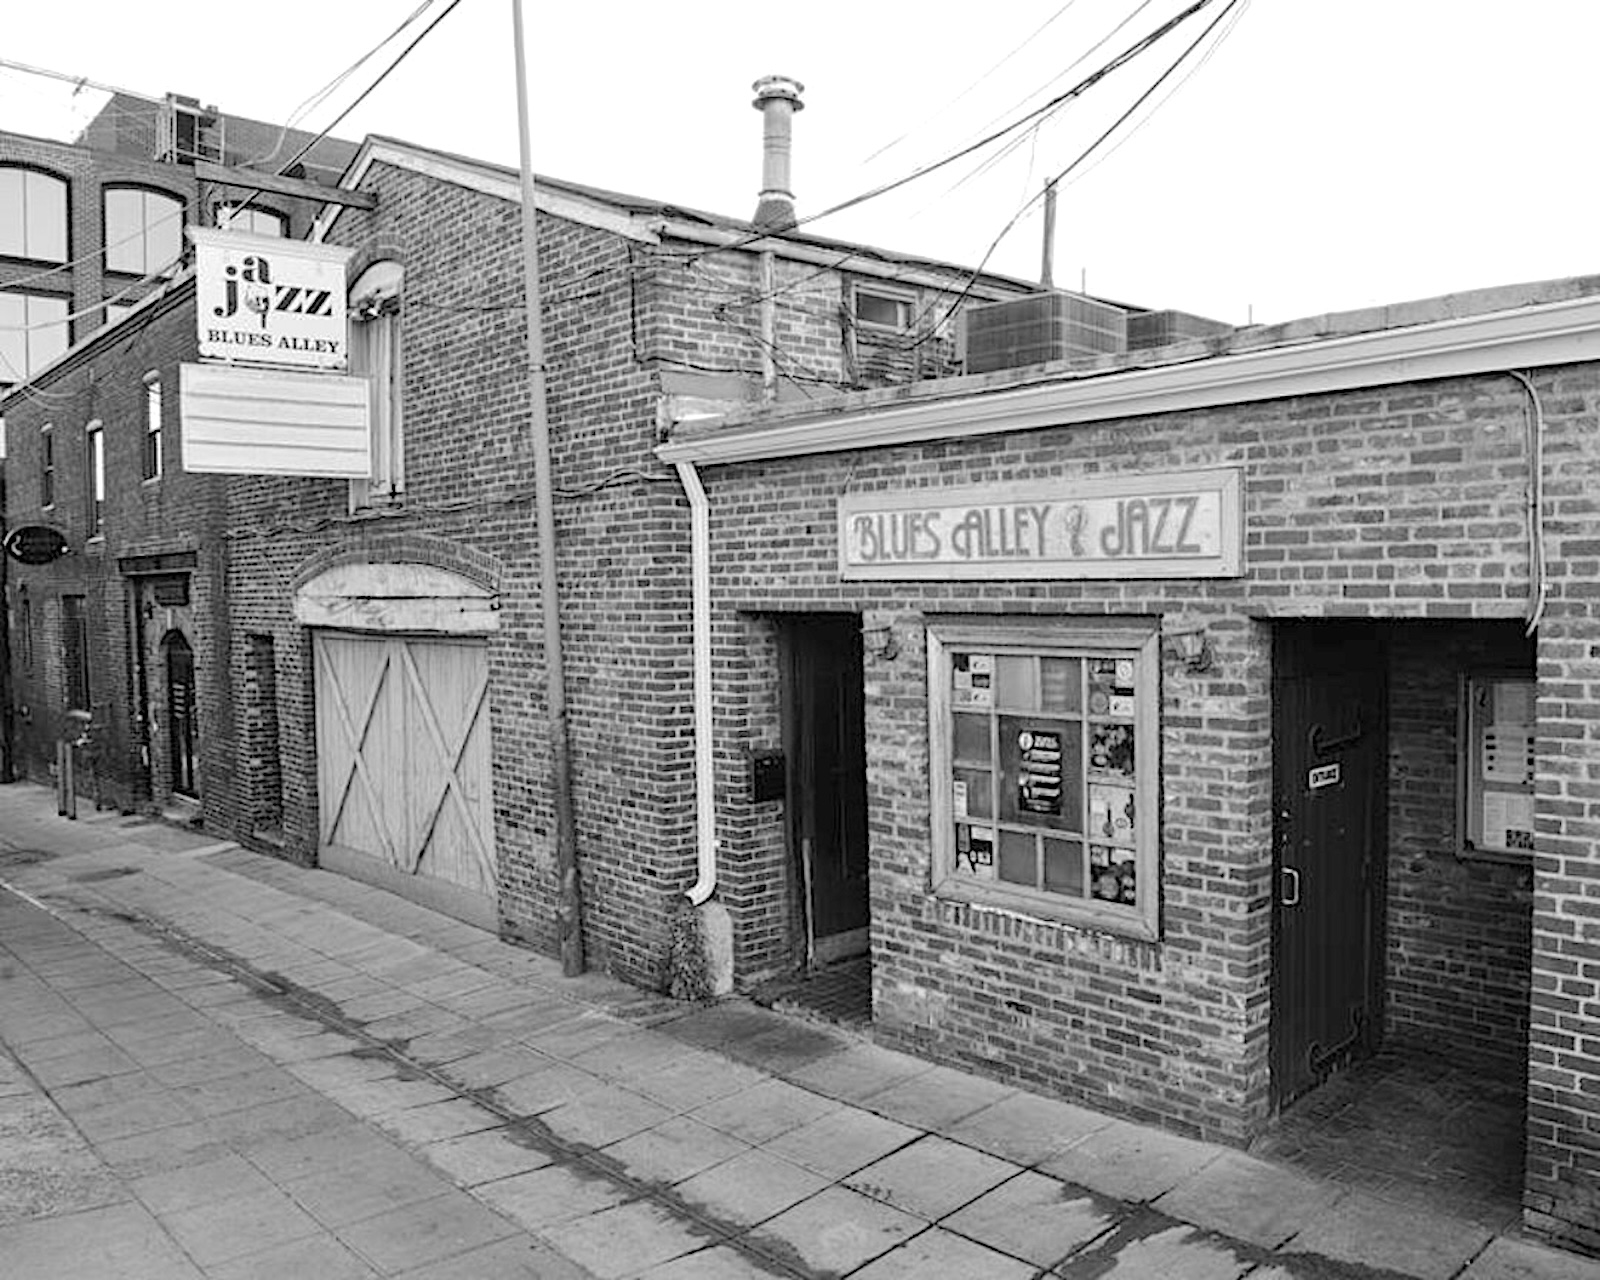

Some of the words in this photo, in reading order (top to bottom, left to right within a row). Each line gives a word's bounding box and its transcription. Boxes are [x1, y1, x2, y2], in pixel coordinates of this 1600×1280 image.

[213, 256, 333, 318] jazz
[208, 329, 273, 348] BLUES
[278, 336, 340, 354] ALLEY
[853, 510, 939, 561] BLUES
[951, 505, 1050, 558] ALLEY
[1100, 496, 1201, 556] JAZZ
